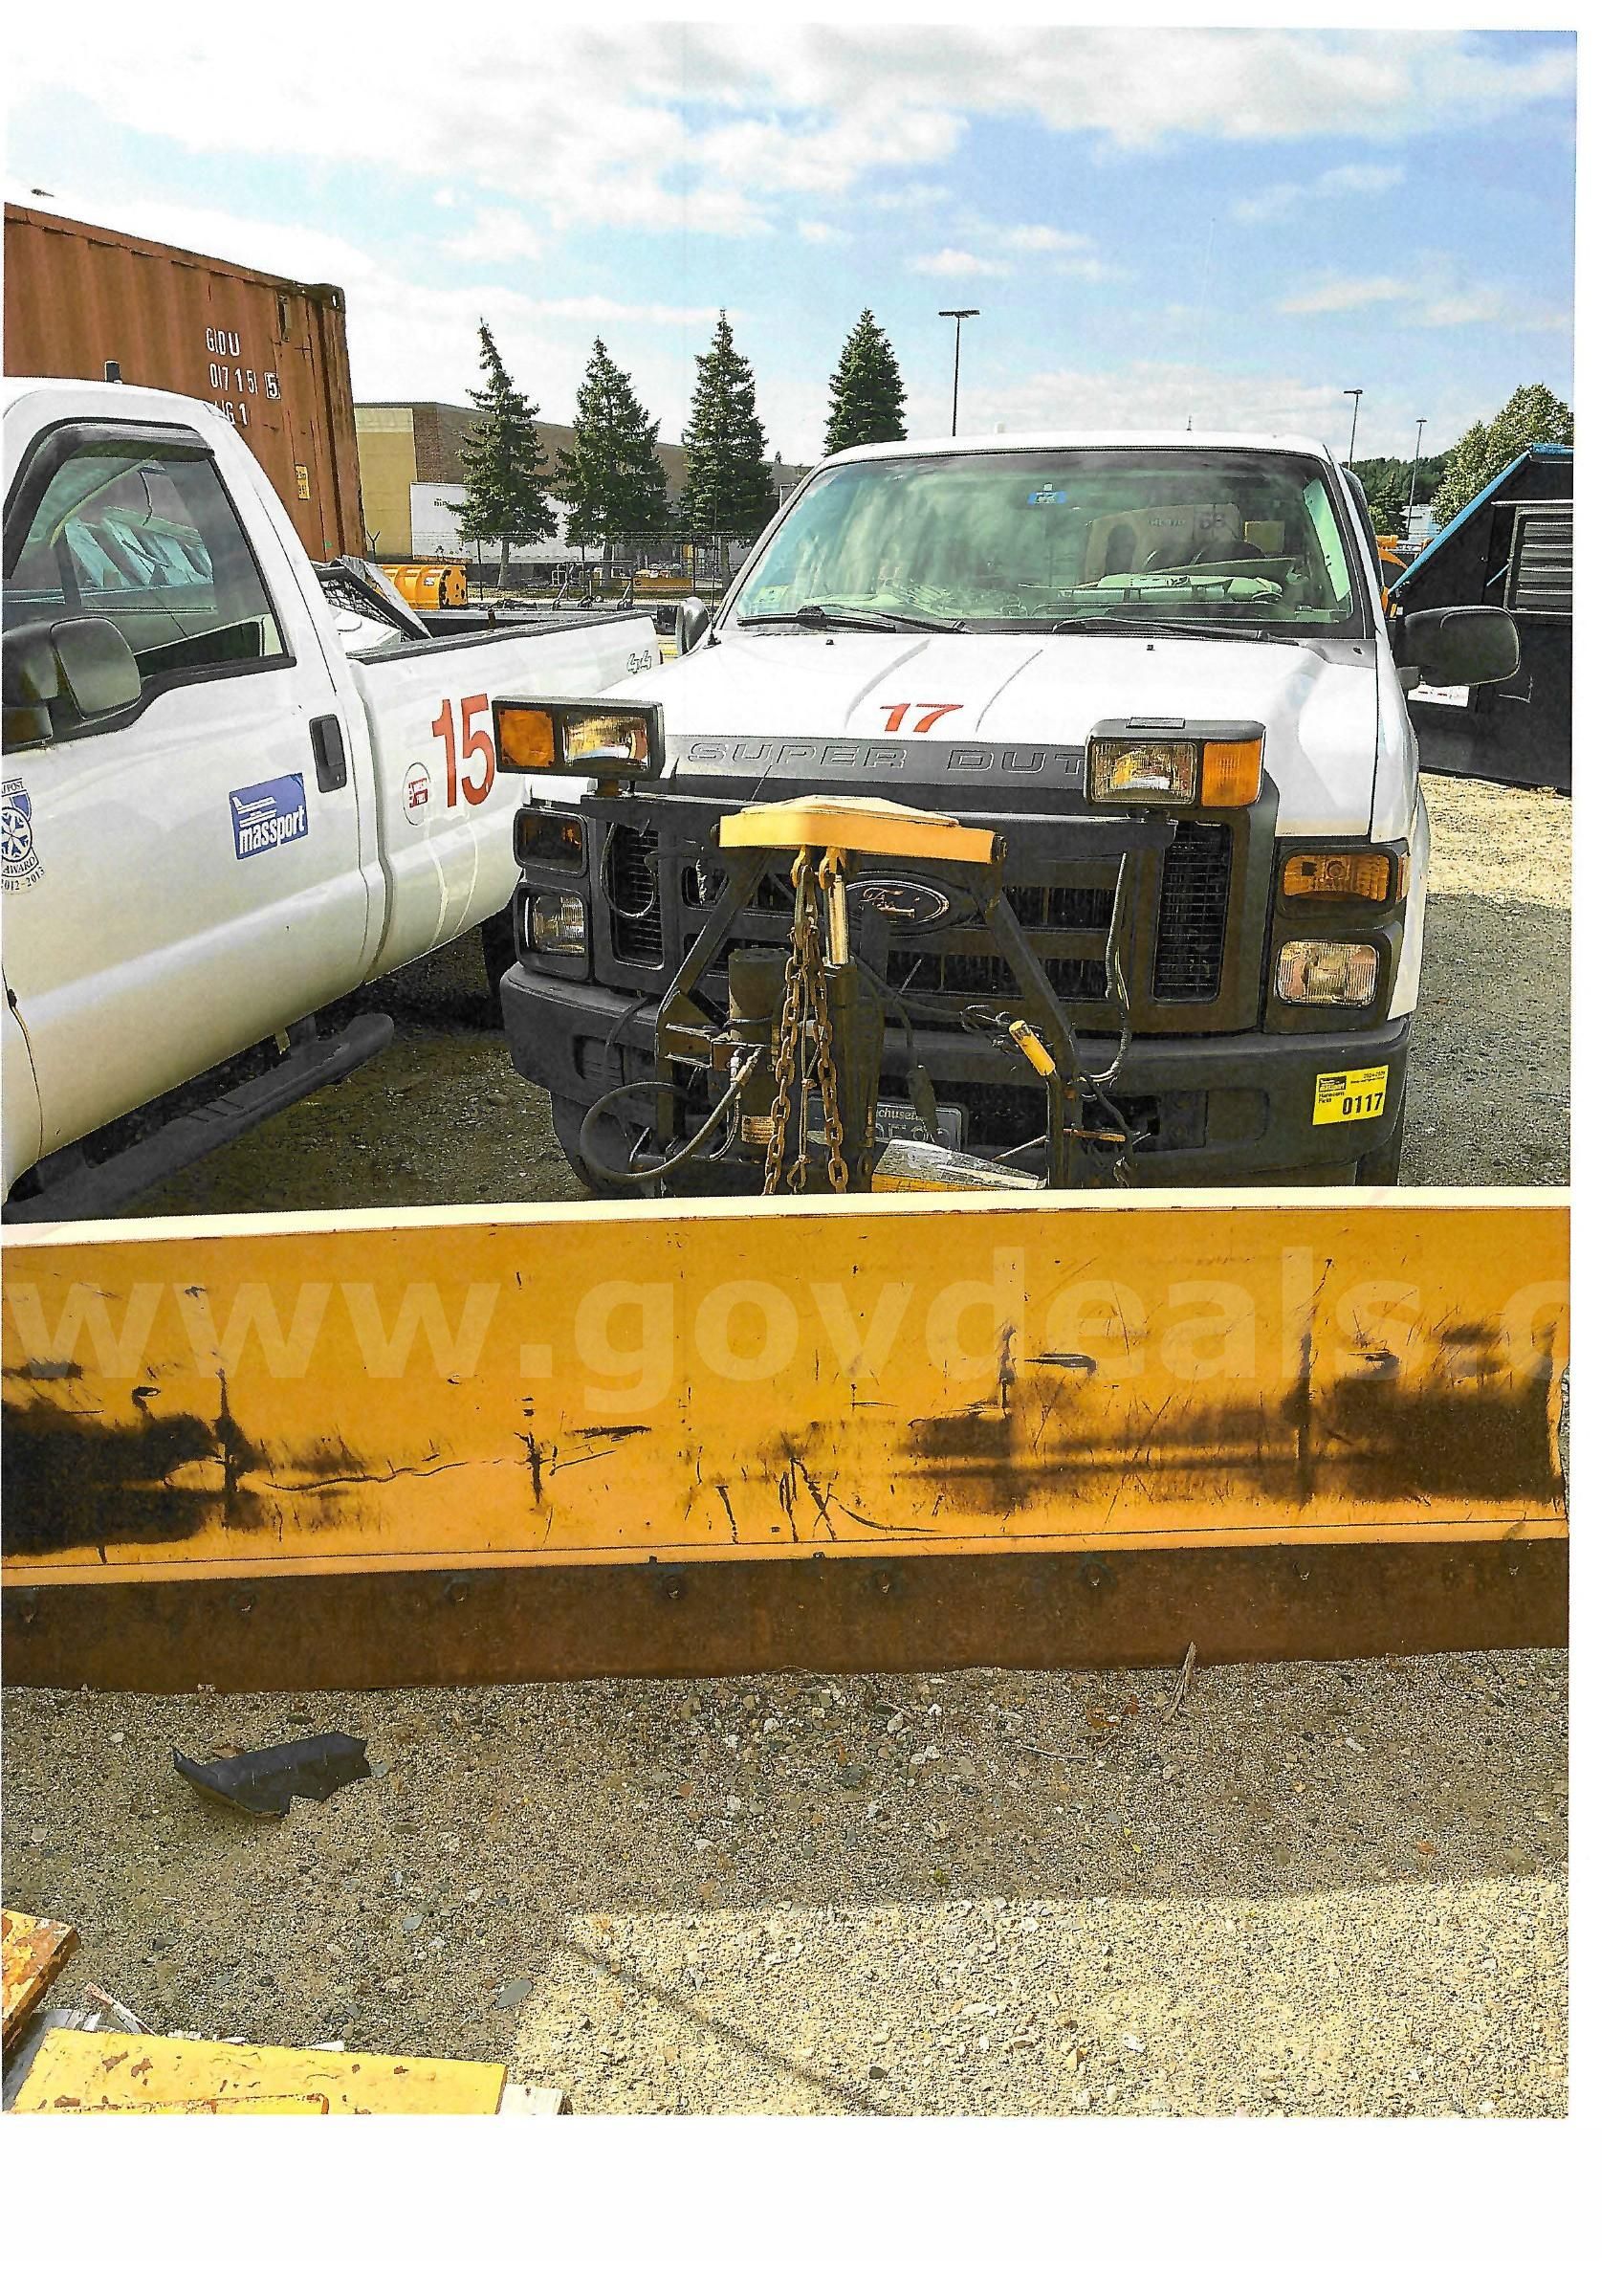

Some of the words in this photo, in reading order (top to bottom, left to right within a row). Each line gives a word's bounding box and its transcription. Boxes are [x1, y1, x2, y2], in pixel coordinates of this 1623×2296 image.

[879, 703, 964, 733] 17
[431, 694, 495, 808] 15
[690, 741, 907, 770] SUPER
[947, 749, 1086, 774] DUT
[239, 805, 305, 854] massport
[3, 856, 35, 874] AWARD
[1342, 1092, 1384, 1115] 0117
